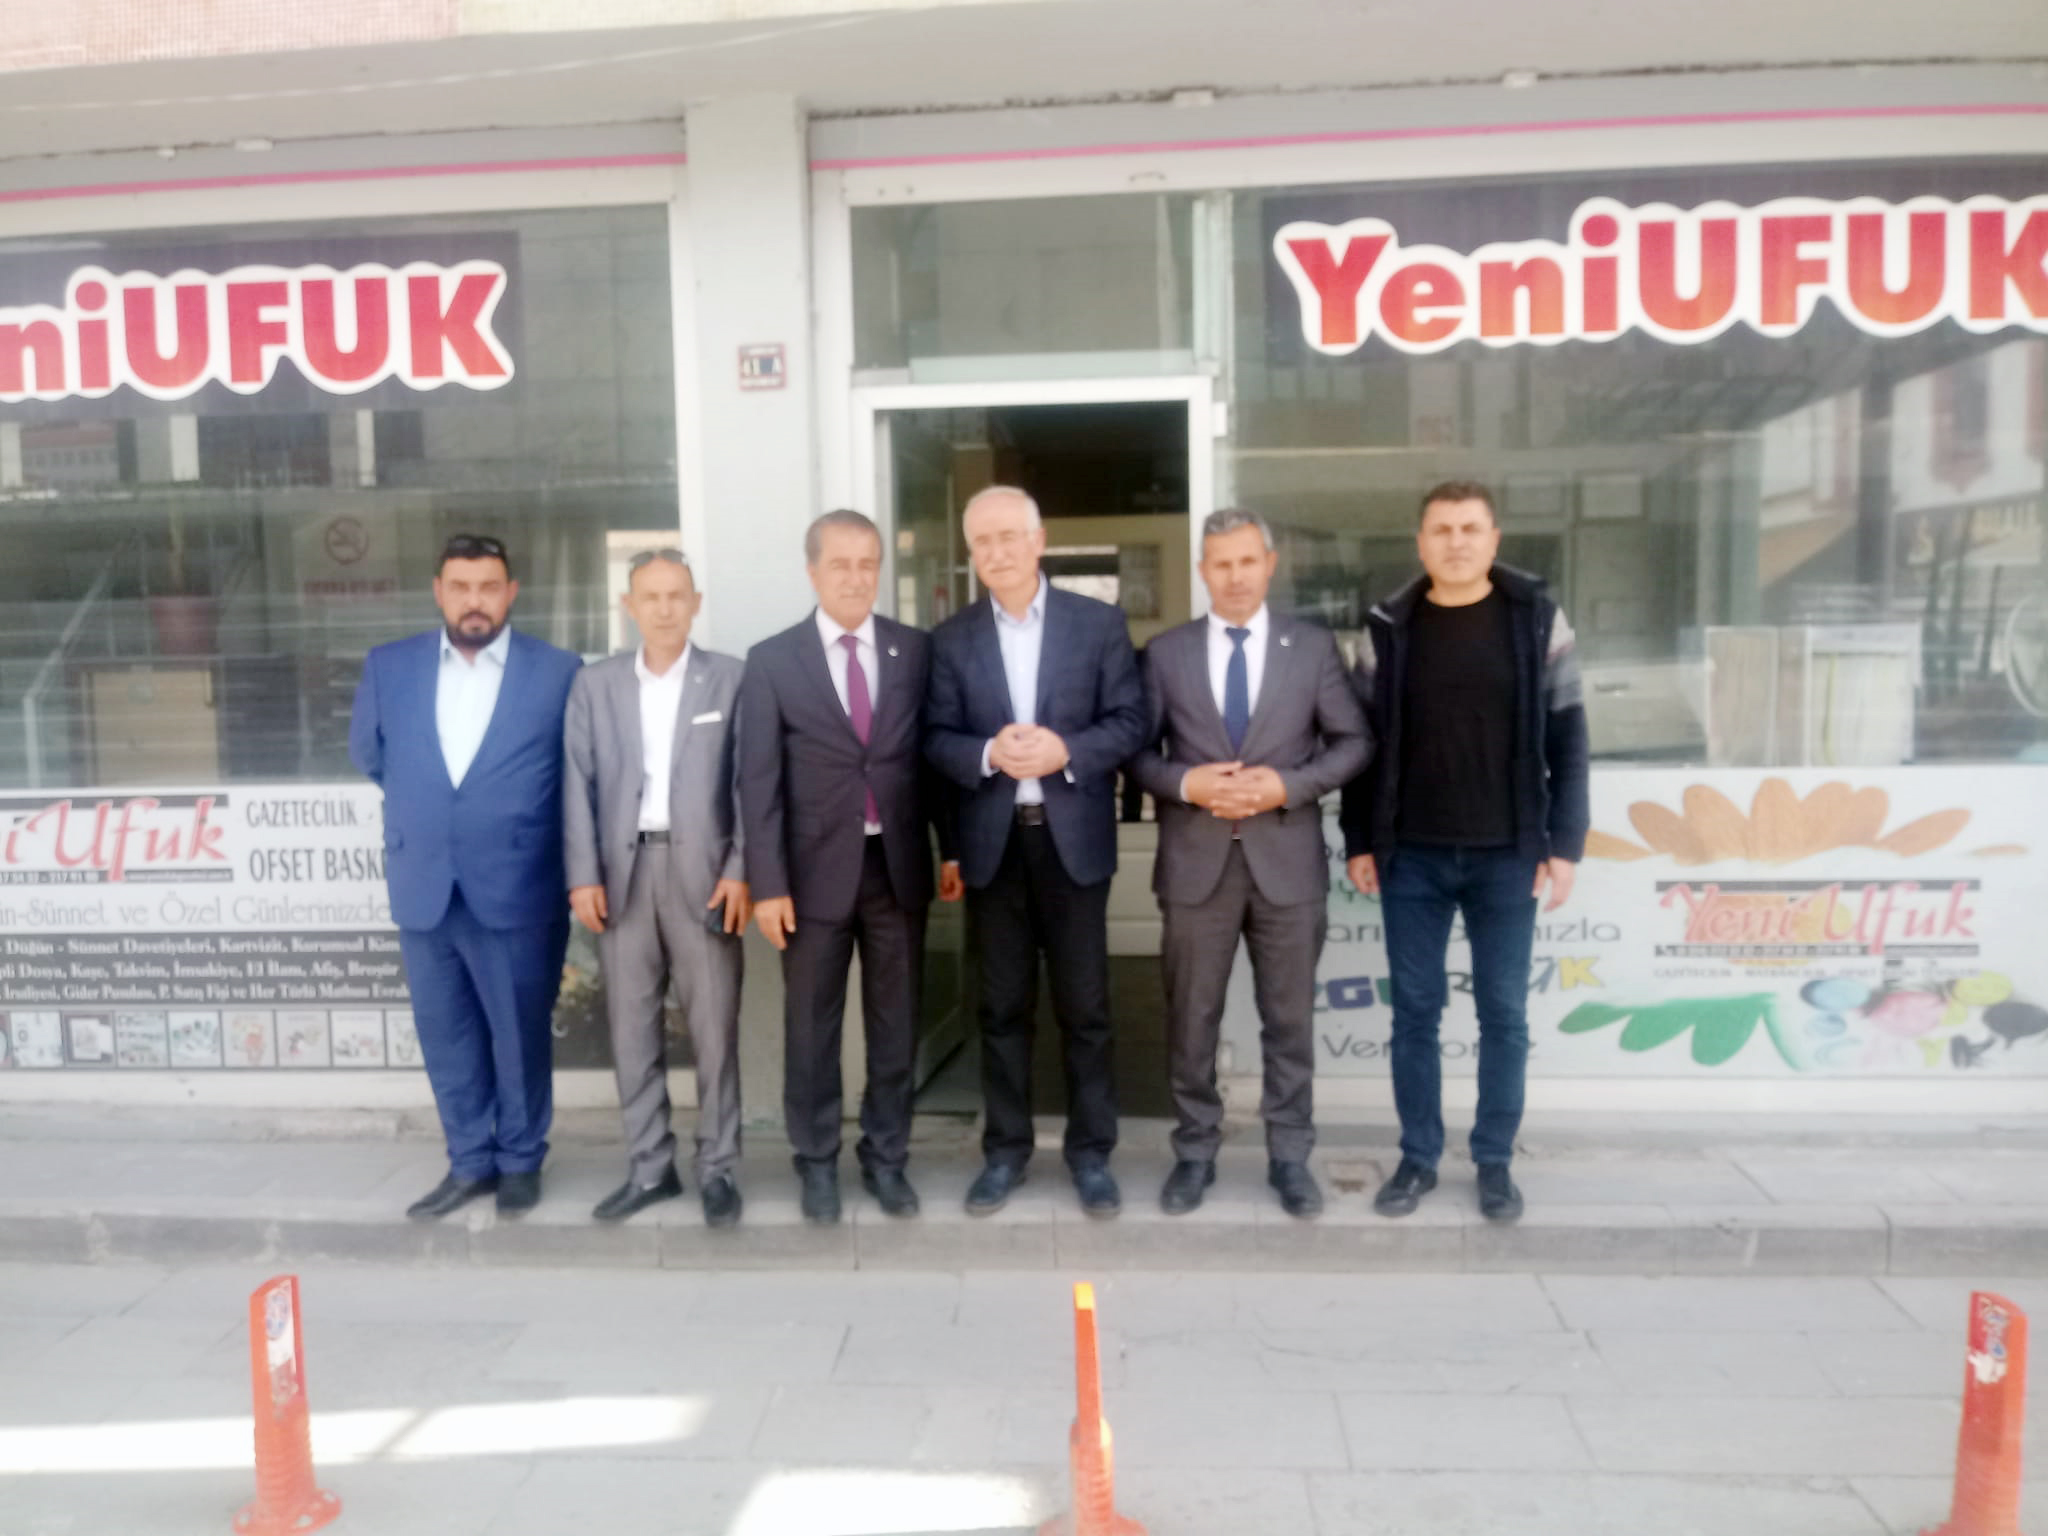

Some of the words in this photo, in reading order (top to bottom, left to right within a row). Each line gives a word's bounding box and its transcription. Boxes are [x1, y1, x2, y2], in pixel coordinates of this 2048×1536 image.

[246, 792, 359, 828] GAZETECİLİK
[26, 796, 229, 883] Ufuk
[249, 848, 316, 882] OFSET
[119, 906, 149, 925] ve
[160, 891, 222, 925] Özel
[231, 896, 391, 926] Günlerinizde
[1799, 882, 1977, 955] Ufuk
[67, 937, 120, 954] Sünnet
[219, 936, 288, 954] Kartvizit,
[291, 935, 364, 953] Kurumsal
[112, 961, 171, 978] Takvim,
[62, 983, 100, 999] Gider
[232, 987, 248, 999] ve
[249, 982, 276, 999] Her
